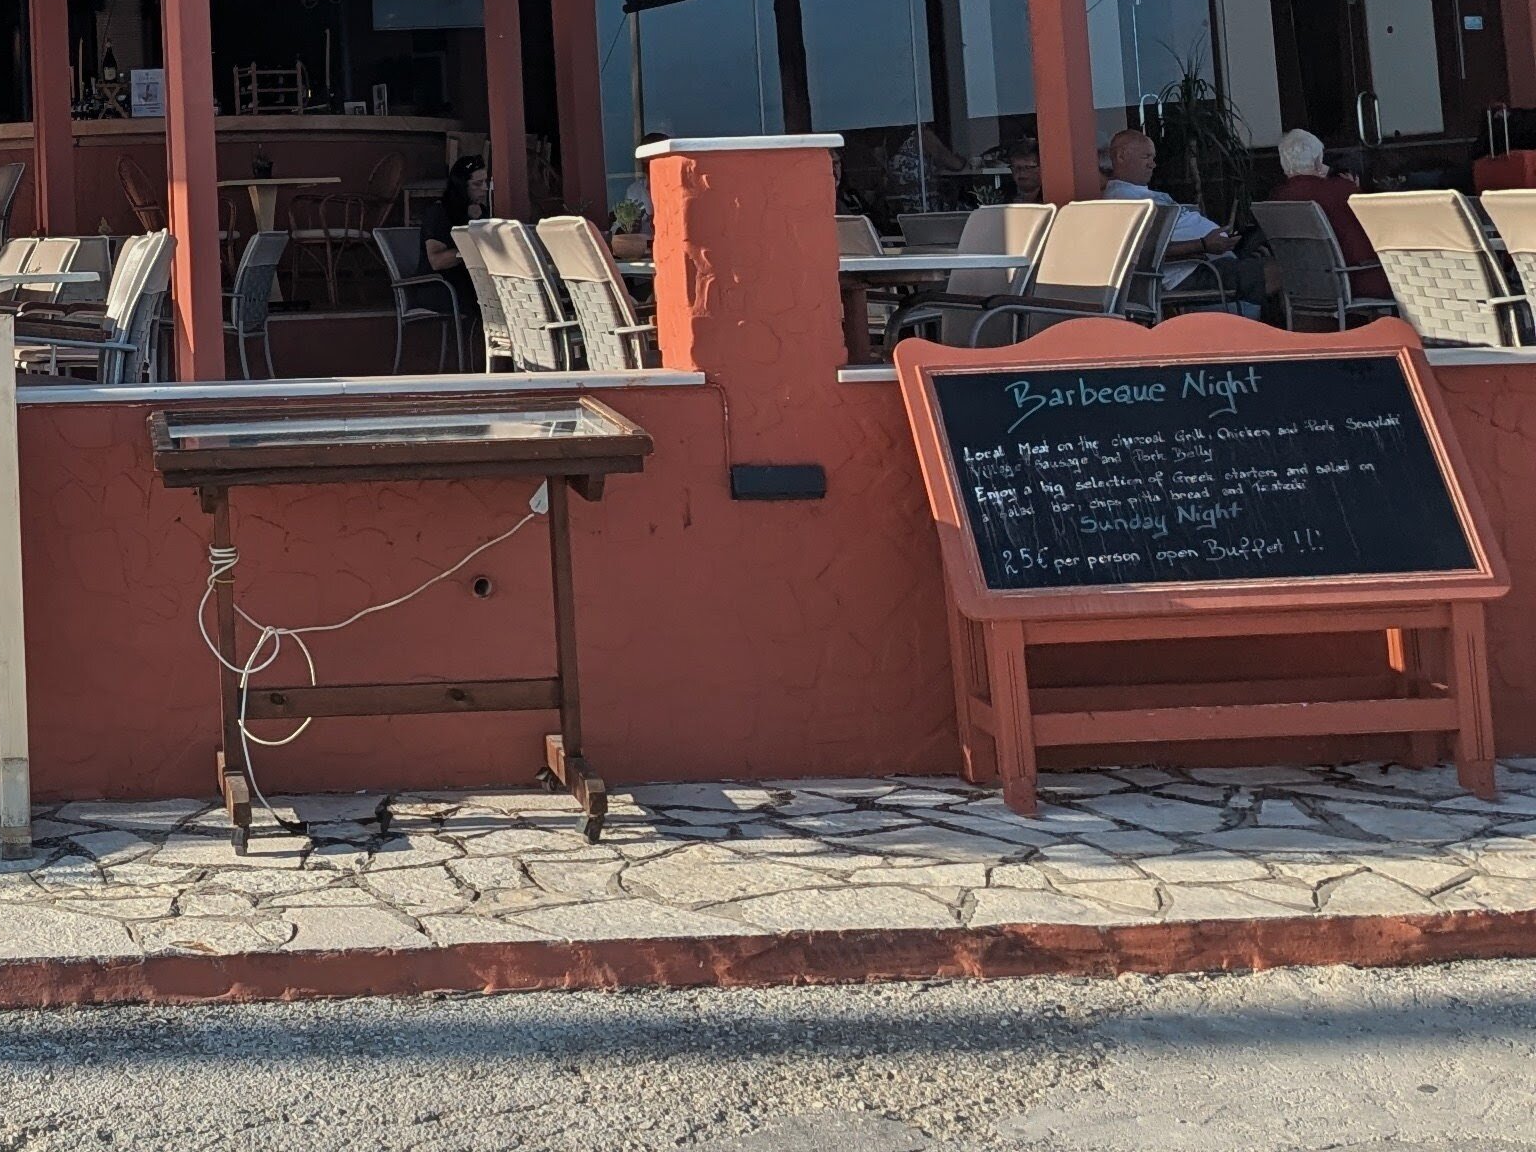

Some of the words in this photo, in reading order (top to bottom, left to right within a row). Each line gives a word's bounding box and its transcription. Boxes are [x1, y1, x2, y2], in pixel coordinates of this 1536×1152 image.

[1005, 377, 1166, 433] Barbeque
[1181, 366, 1263, 419] Night
[964, 445, 1005, 462] Local
[1018, 439, 1050, 456] Meat
[1057, 442, 1074, 452] on
[1078, 435, 1099, 451] the
[1217, 426, 1271, 441] Chicken
[1278, 422, 1298, 436] and
[1101, 452, 1122, 465] and
[1132, 448, 1167, 462] Pork
[1172, 445, 1213, 463] Belly
[975, 485, 1018, 505] Enjoy
[1023, 485, 1033, 496] a
[1040, 480, 1065, 499] big
[1075, 476, 1143, 492] selection
[1147, 470, 1164, 487] of
[1172, 470, 1216, 484] Greek
[1224, 466, 1278, 481] starters
[1286, 463, 1309, 476] and
[1316, 460, 1350, 475] salad
[1359, 462, 1376, 473] on
[1089, 496, 1122, 512] chips
[1169, 486, 1211, 500] bread
[1222, 483, 1244, 496] and
[1079, 514, 1169, 539] Sunday
[1177, 502, 1243, 530] Night
[1053, 555, 1081, 575] per
[1087, 551, 1141, 573] person
[1155, 548, 1199, 567] open
